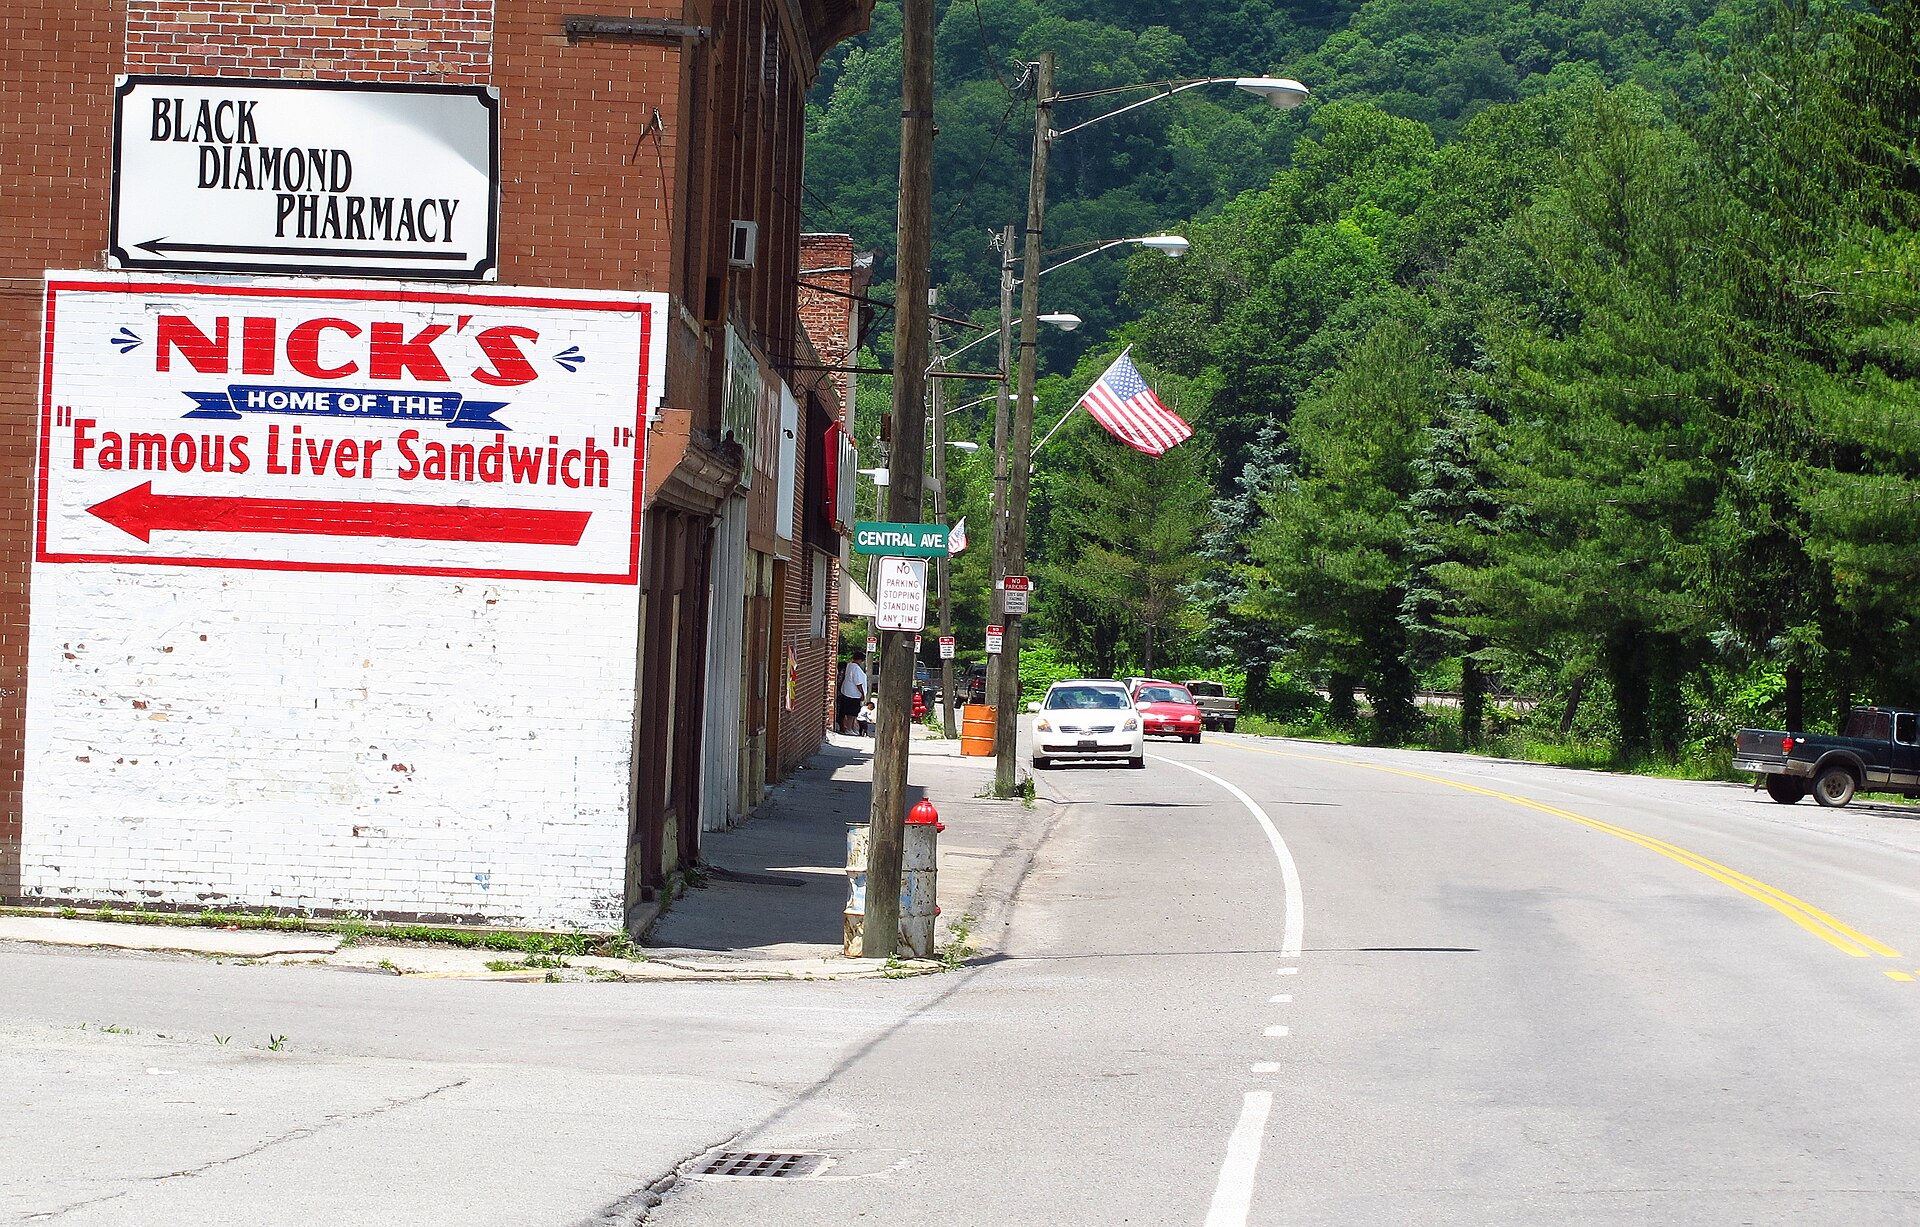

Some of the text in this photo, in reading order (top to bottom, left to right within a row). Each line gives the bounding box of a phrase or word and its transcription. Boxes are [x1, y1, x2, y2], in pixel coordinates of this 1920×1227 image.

[150, 97, 258, 145] BLACK
[198, 146, 352, 193] DIAMOND
[274, 193, 460, 243] PHARMACY
[157, 315, 541, 387] NICK'S
[247, 391, 443, 416] HOME OF THE
[57, 406, 630, 489] "Famous Liver Sandwich"
[858, 531, 946, 548] CENTRAL AVE.
[896, 565, 911, 575] NO
[886, 578, 919, 589] PARKING
[883, 590, 920, 600] STOPPING
[882, 601, 920, 612] STANDING
[882, 613, 919, 624] ANY TIME
